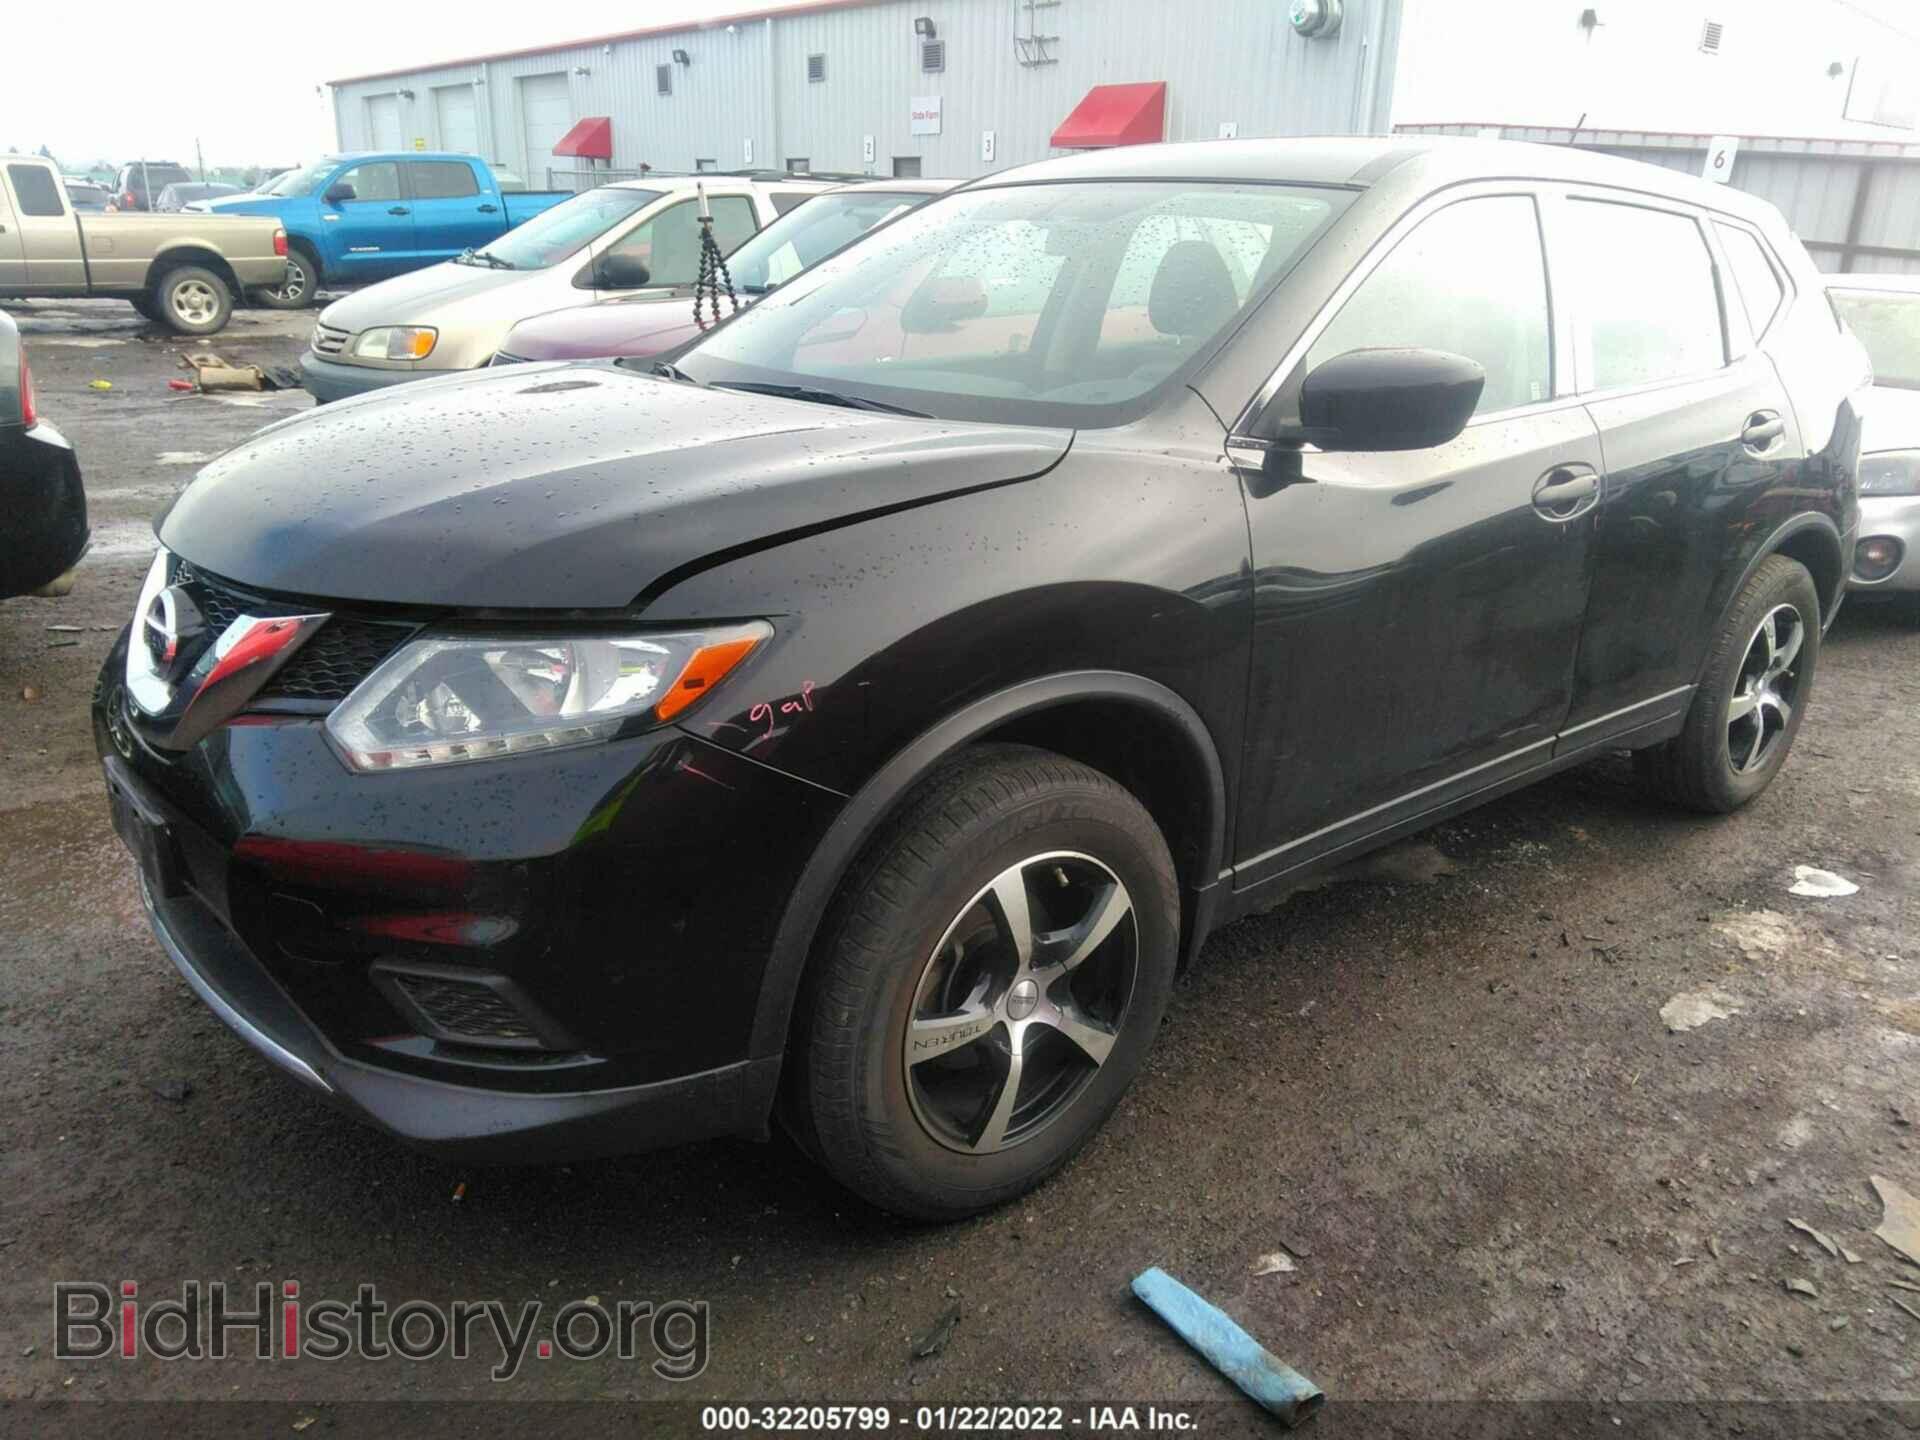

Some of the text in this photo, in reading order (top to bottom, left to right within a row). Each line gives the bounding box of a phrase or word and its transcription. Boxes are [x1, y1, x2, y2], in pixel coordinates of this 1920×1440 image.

[866, 142, 872, 154] 2
[985, 139, 992, 152] 3
[1714, 149, 1725, 169] 6
